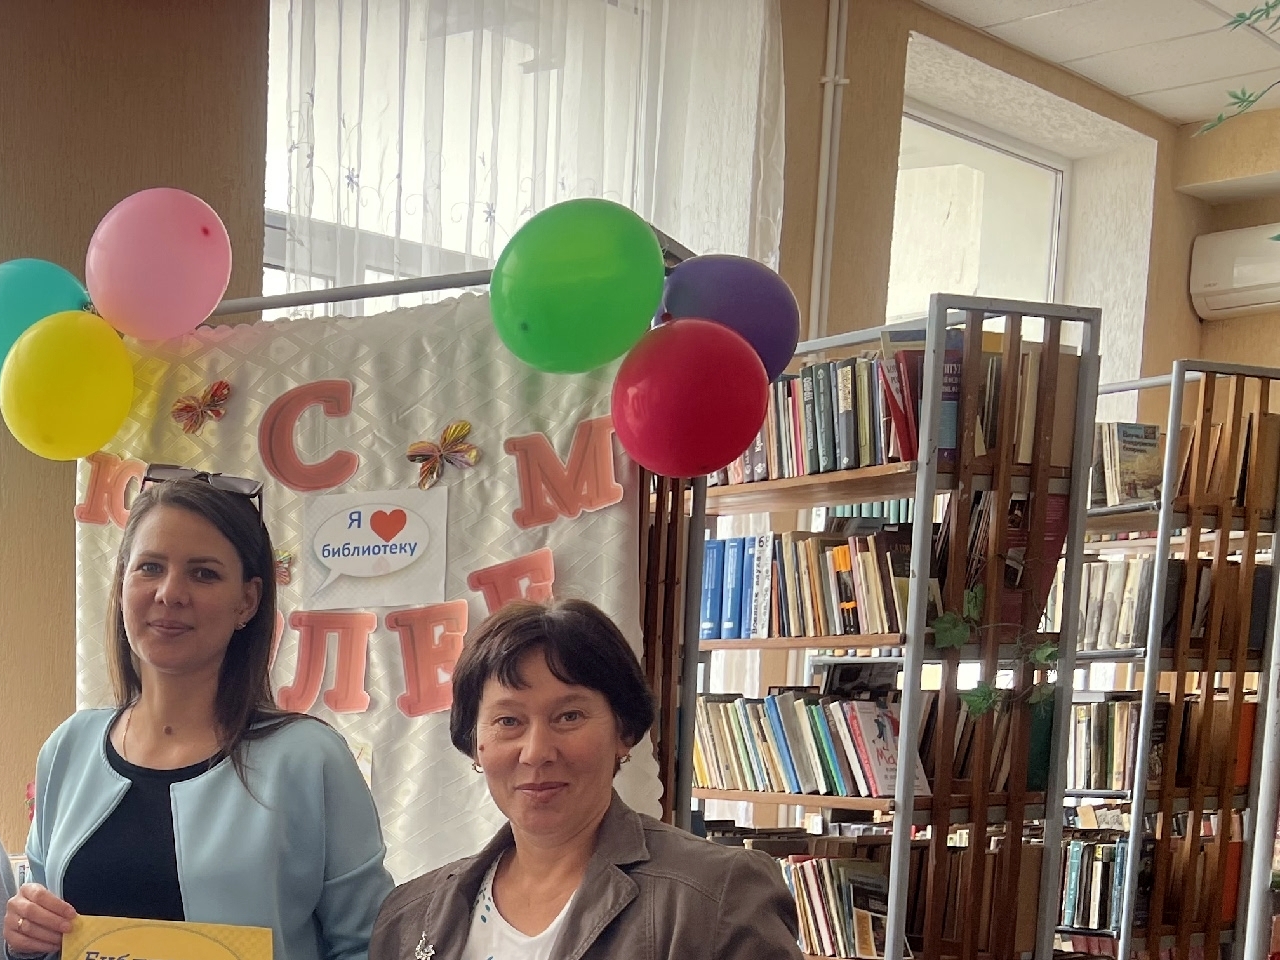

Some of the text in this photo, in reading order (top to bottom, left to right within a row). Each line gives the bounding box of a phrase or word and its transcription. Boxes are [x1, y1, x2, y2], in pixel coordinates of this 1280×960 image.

[259, 379, 359, 492] С
[347, 510, 362, 529] Я
[322, 542, 417, 558] библиотеку
